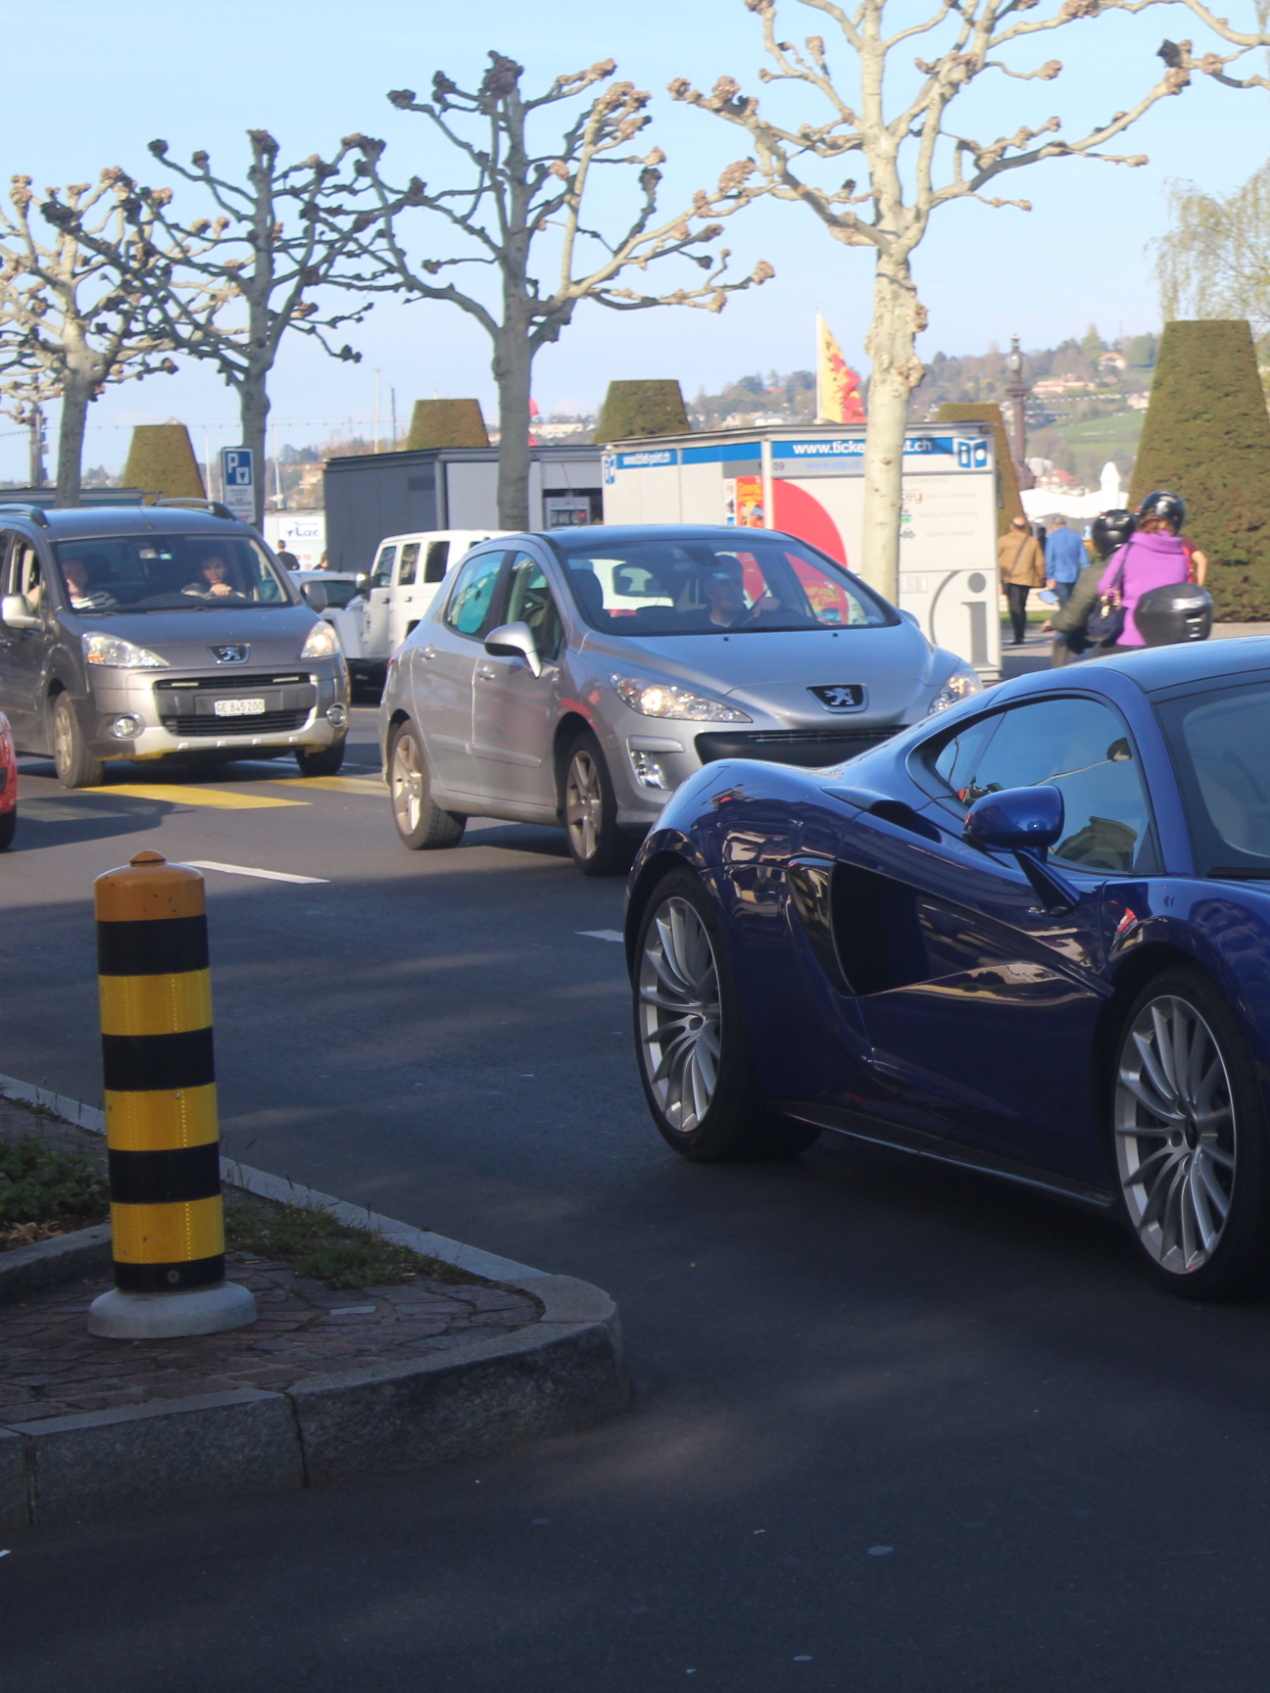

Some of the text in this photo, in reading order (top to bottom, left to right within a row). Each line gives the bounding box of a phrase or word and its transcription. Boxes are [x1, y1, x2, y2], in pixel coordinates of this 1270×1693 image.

[227, 453, 238, 473] P
[295, 527, 319, 537] Lac
[216, 702, 228, 713] GE
